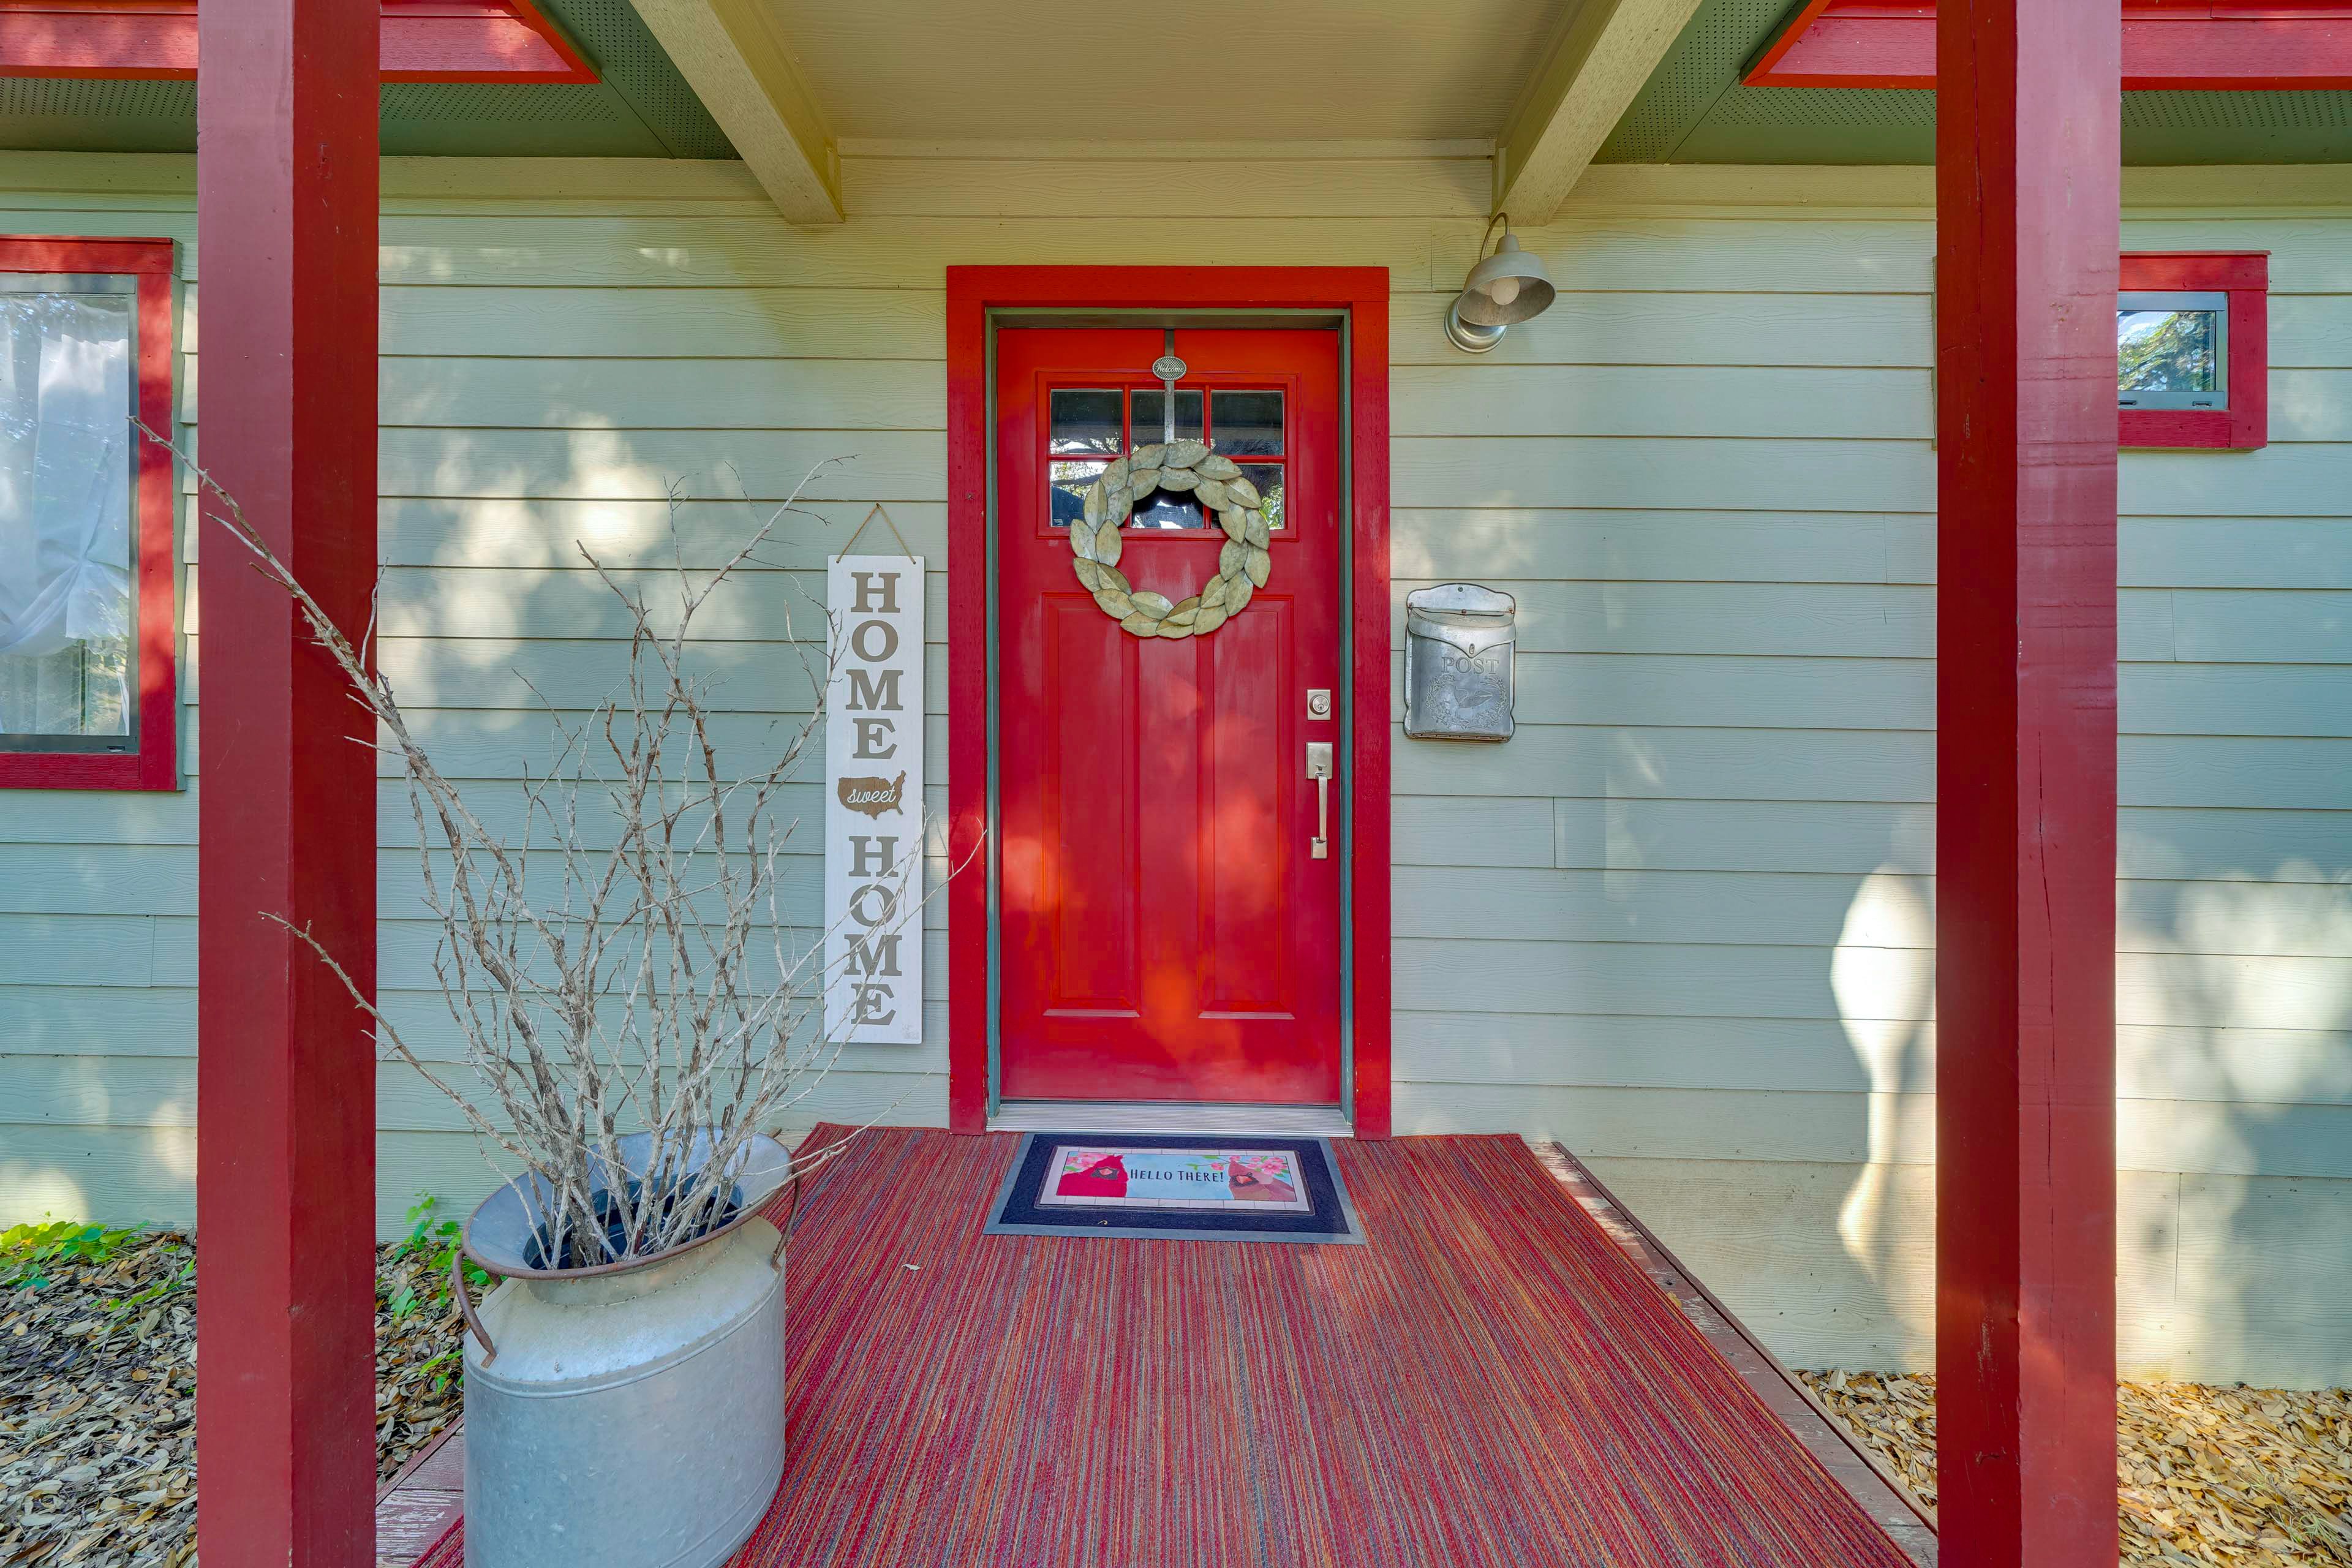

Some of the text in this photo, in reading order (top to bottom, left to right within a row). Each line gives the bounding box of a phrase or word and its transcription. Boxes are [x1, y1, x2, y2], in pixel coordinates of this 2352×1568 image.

[1155, 362, 1185, 373] Welcome
[845, 572, 903, 760] HOME
[1441, 656, 1499, 674] POST
[847, 786, 896, 804] sweet
[844, 835, 902, 1025] HOME
[1130, 1169, 1224, 1182] HELLO THERE!
